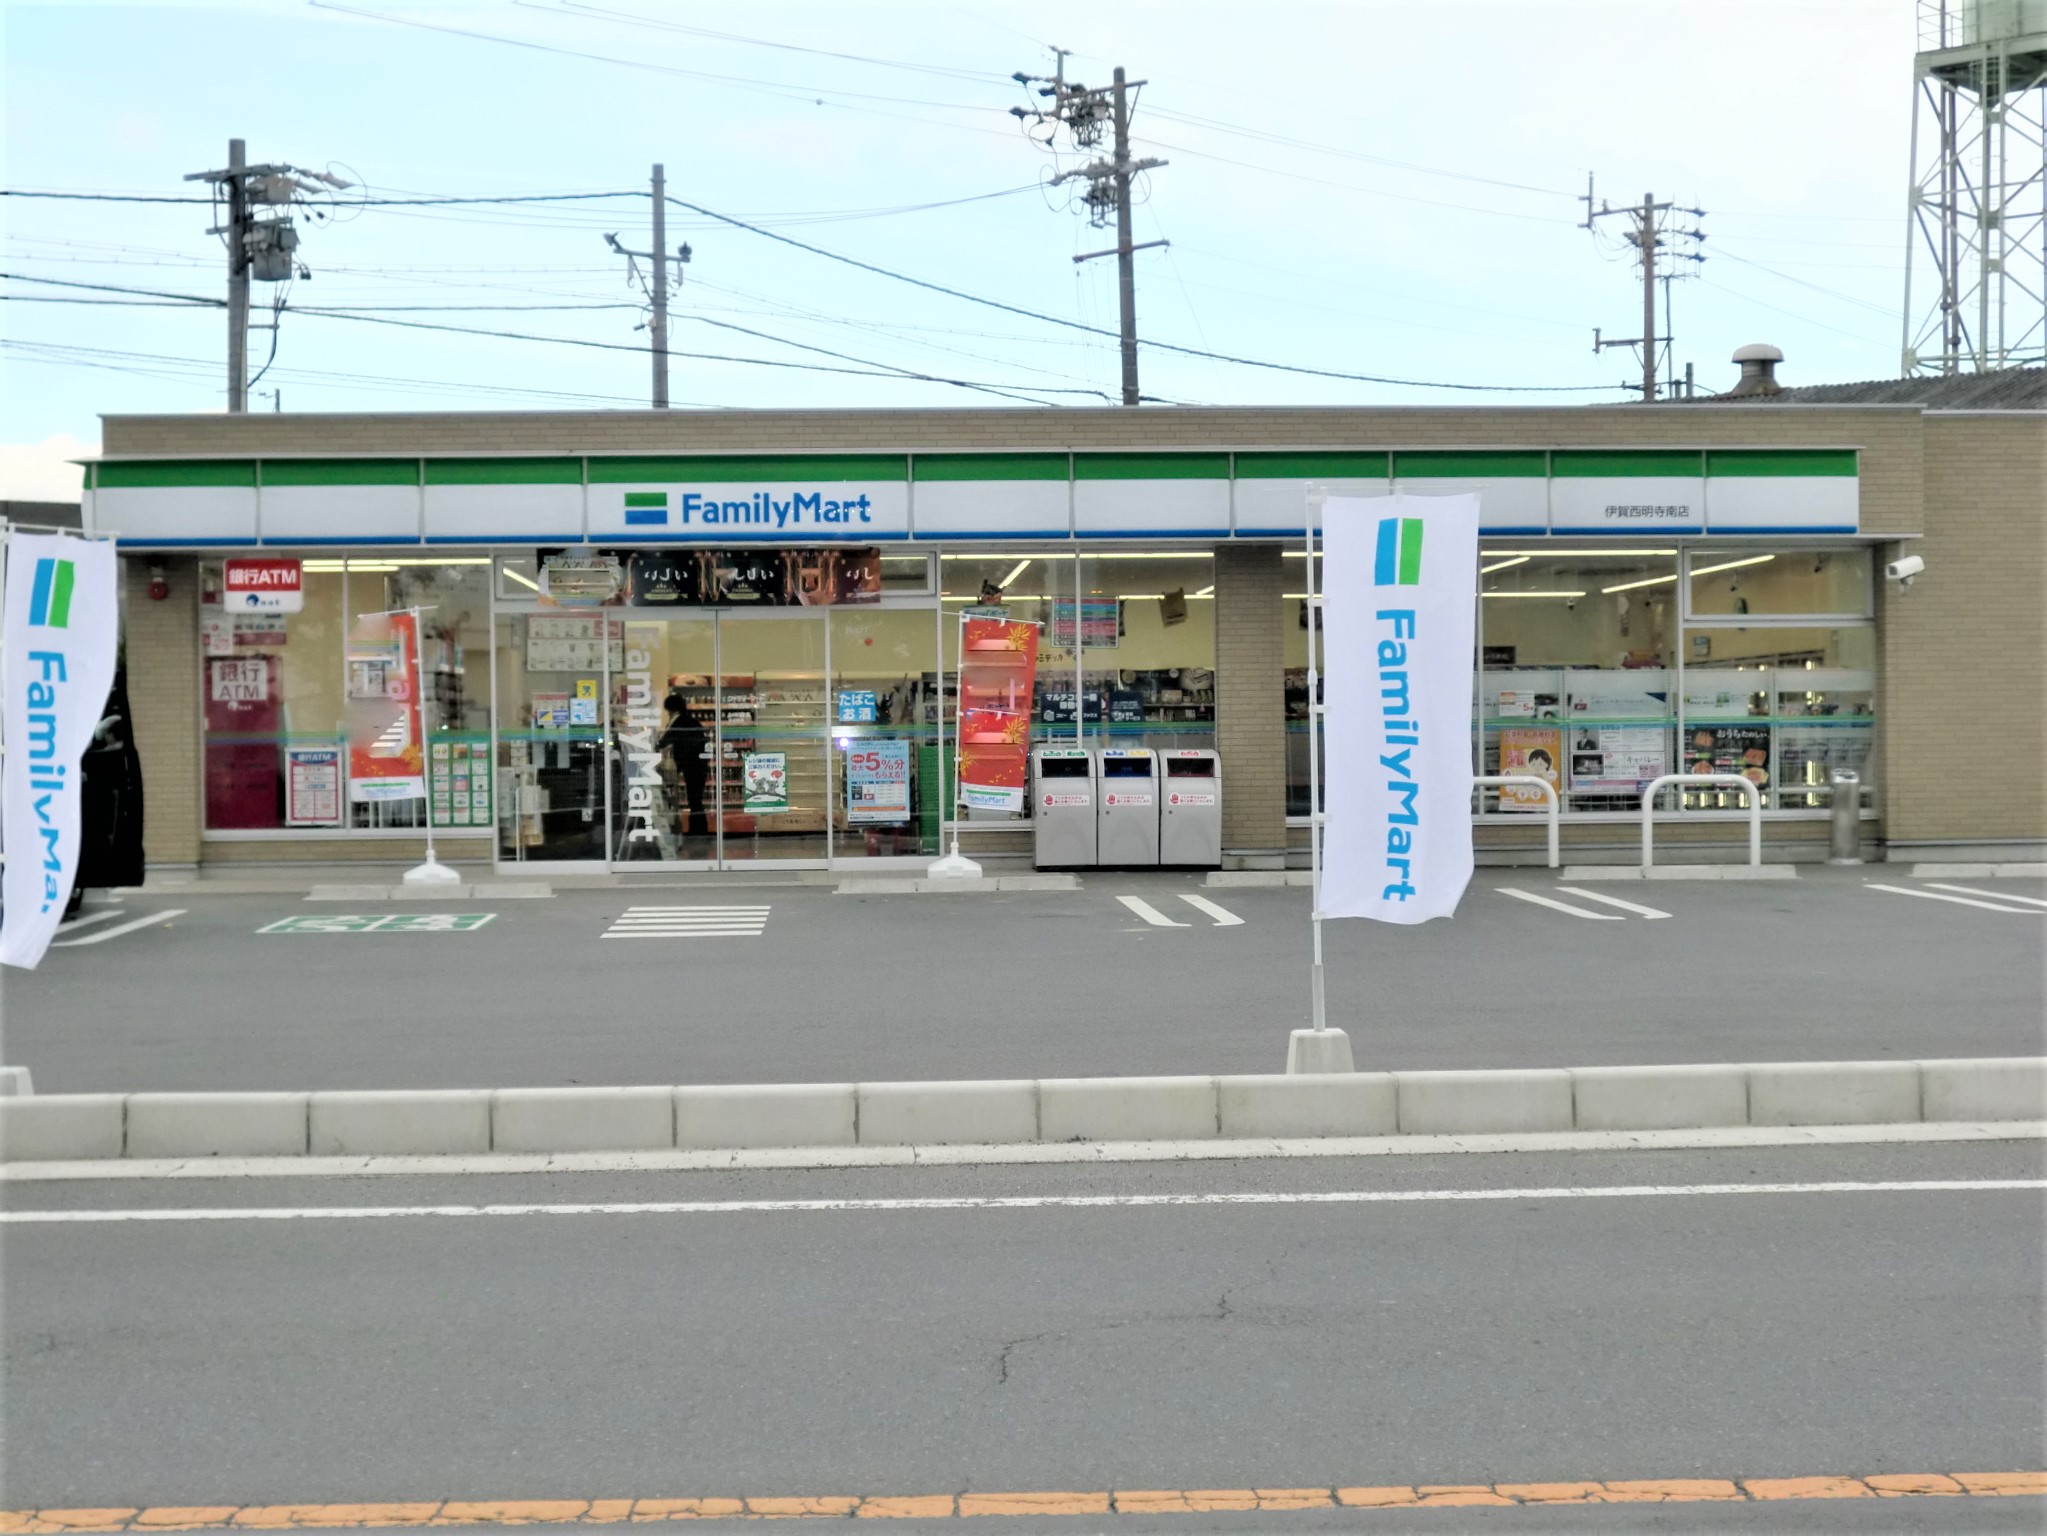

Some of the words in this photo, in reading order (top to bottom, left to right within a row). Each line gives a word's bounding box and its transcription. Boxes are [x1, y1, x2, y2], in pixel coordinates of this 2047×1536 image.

[682, 492, 871, 528] FamilyMart
[1605, 505, 1690, 518] 伊賀西明寺南店
[228, 568, 298, 585] 銀行ATM
[219, 662, 261, 683] 銀行
[219, 686, 261, 699] ATM
[839, 693, 875, 706] たばこ
[843, 708, 873, 720] お酒
[618, 627, 662, 842] FamilyMart
[1375, 609, 1420, 902] FamilyMart
[968, 794, 1006, 805] FamilyMart
